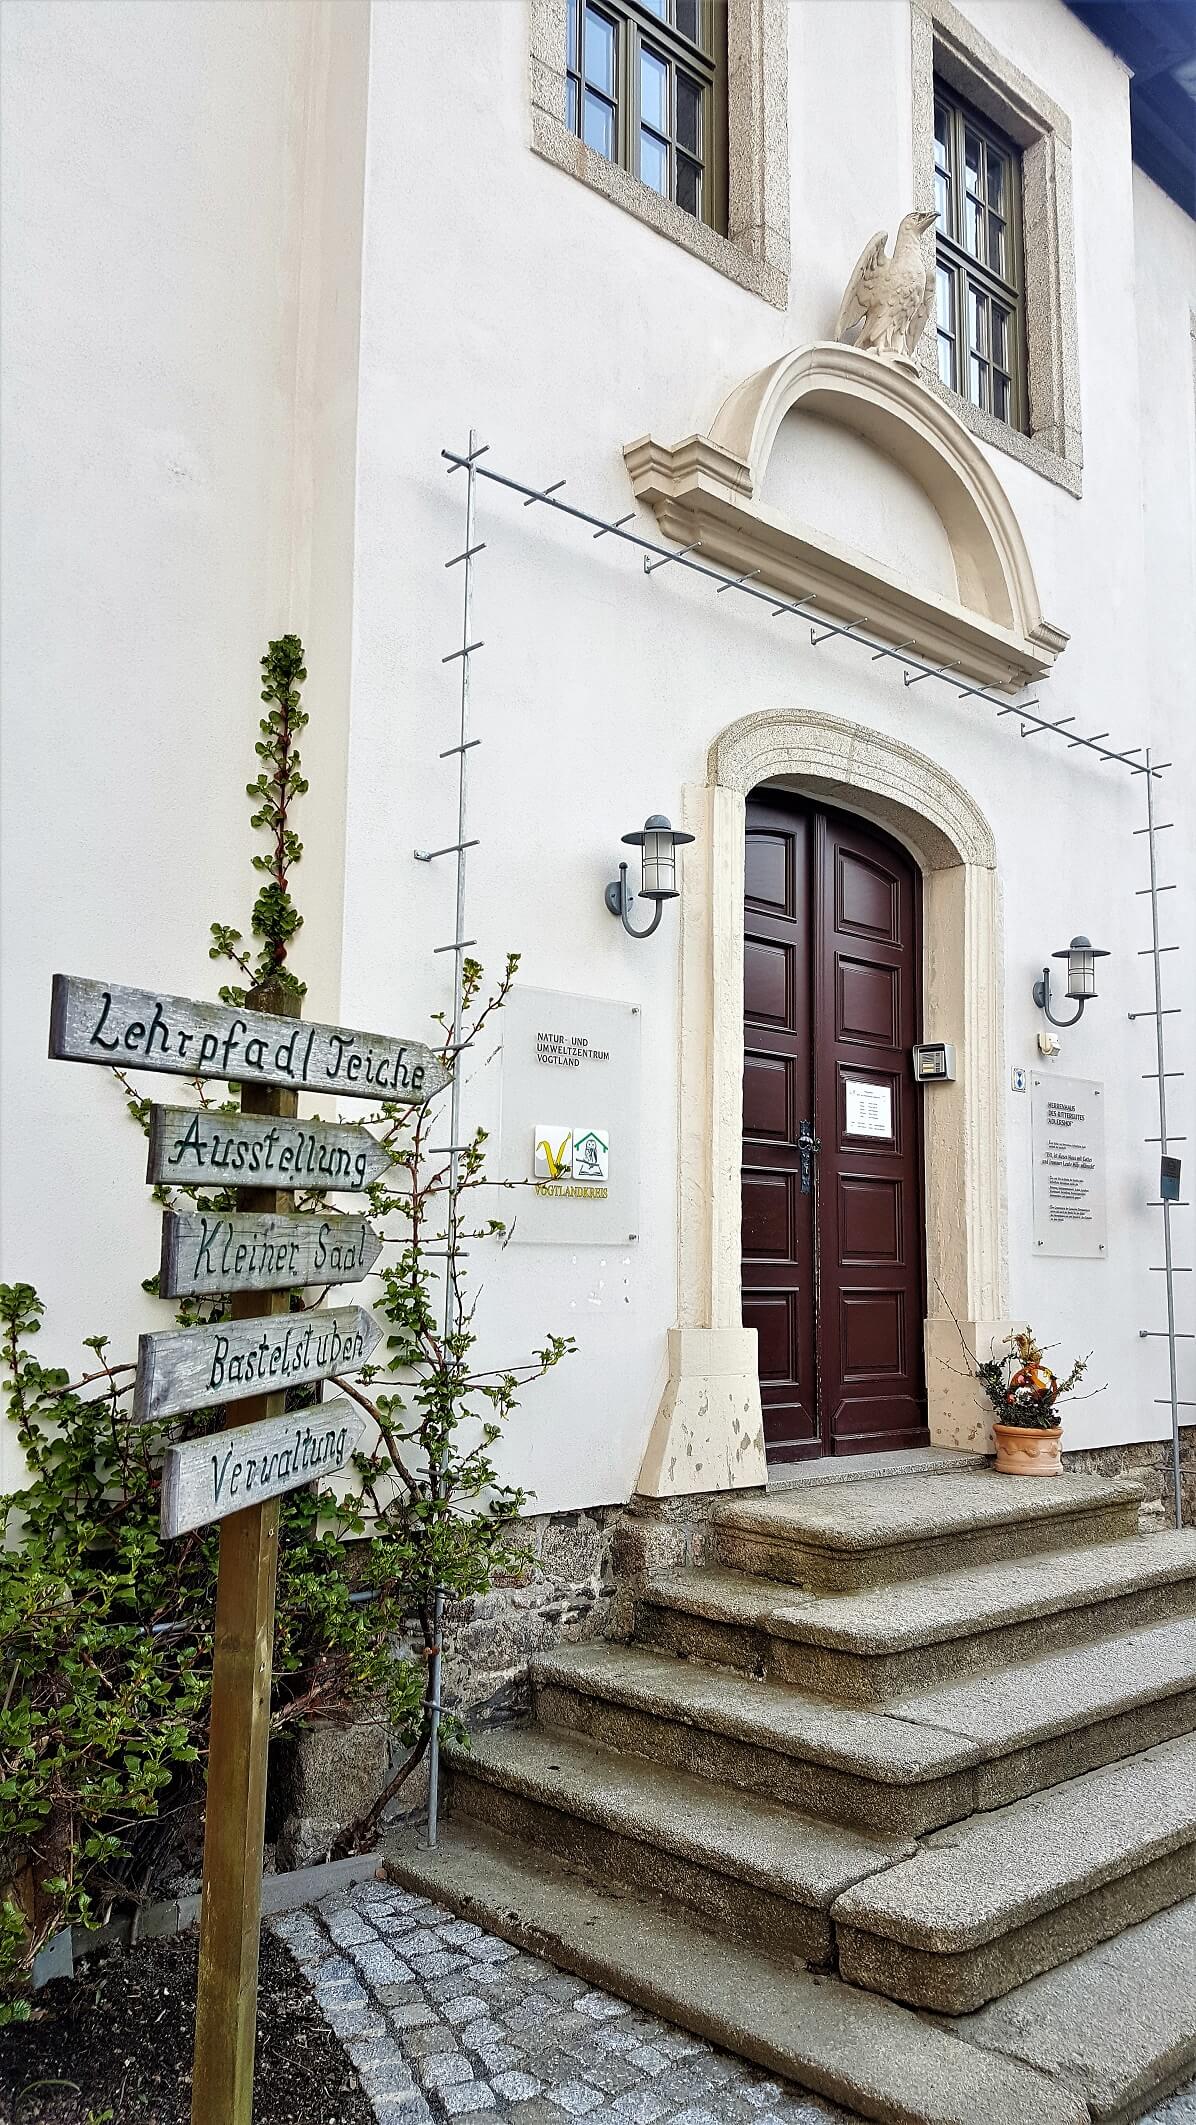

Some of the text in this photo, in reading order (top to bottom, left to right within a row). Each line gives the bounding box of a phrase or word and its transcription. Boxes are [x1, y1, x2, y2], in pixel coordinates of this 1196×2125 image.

[536, 1043, 610, 1060] UMWELTZENTRUM
[537, 1032, 588, 1047] NATUR- UND
[536, 1053, 580, 1067] VOGTLAND
[168, 1114, 367, 1188] Ausstellung
[535, 1184, 608, 1199] VOGTLANDKREIS
[194, 1217, 367, 1281] Kleiner Saal
[206, 1319, 364, 1391] Bastelstuben
[212, 1425, 347, 1504] Verwaltung
